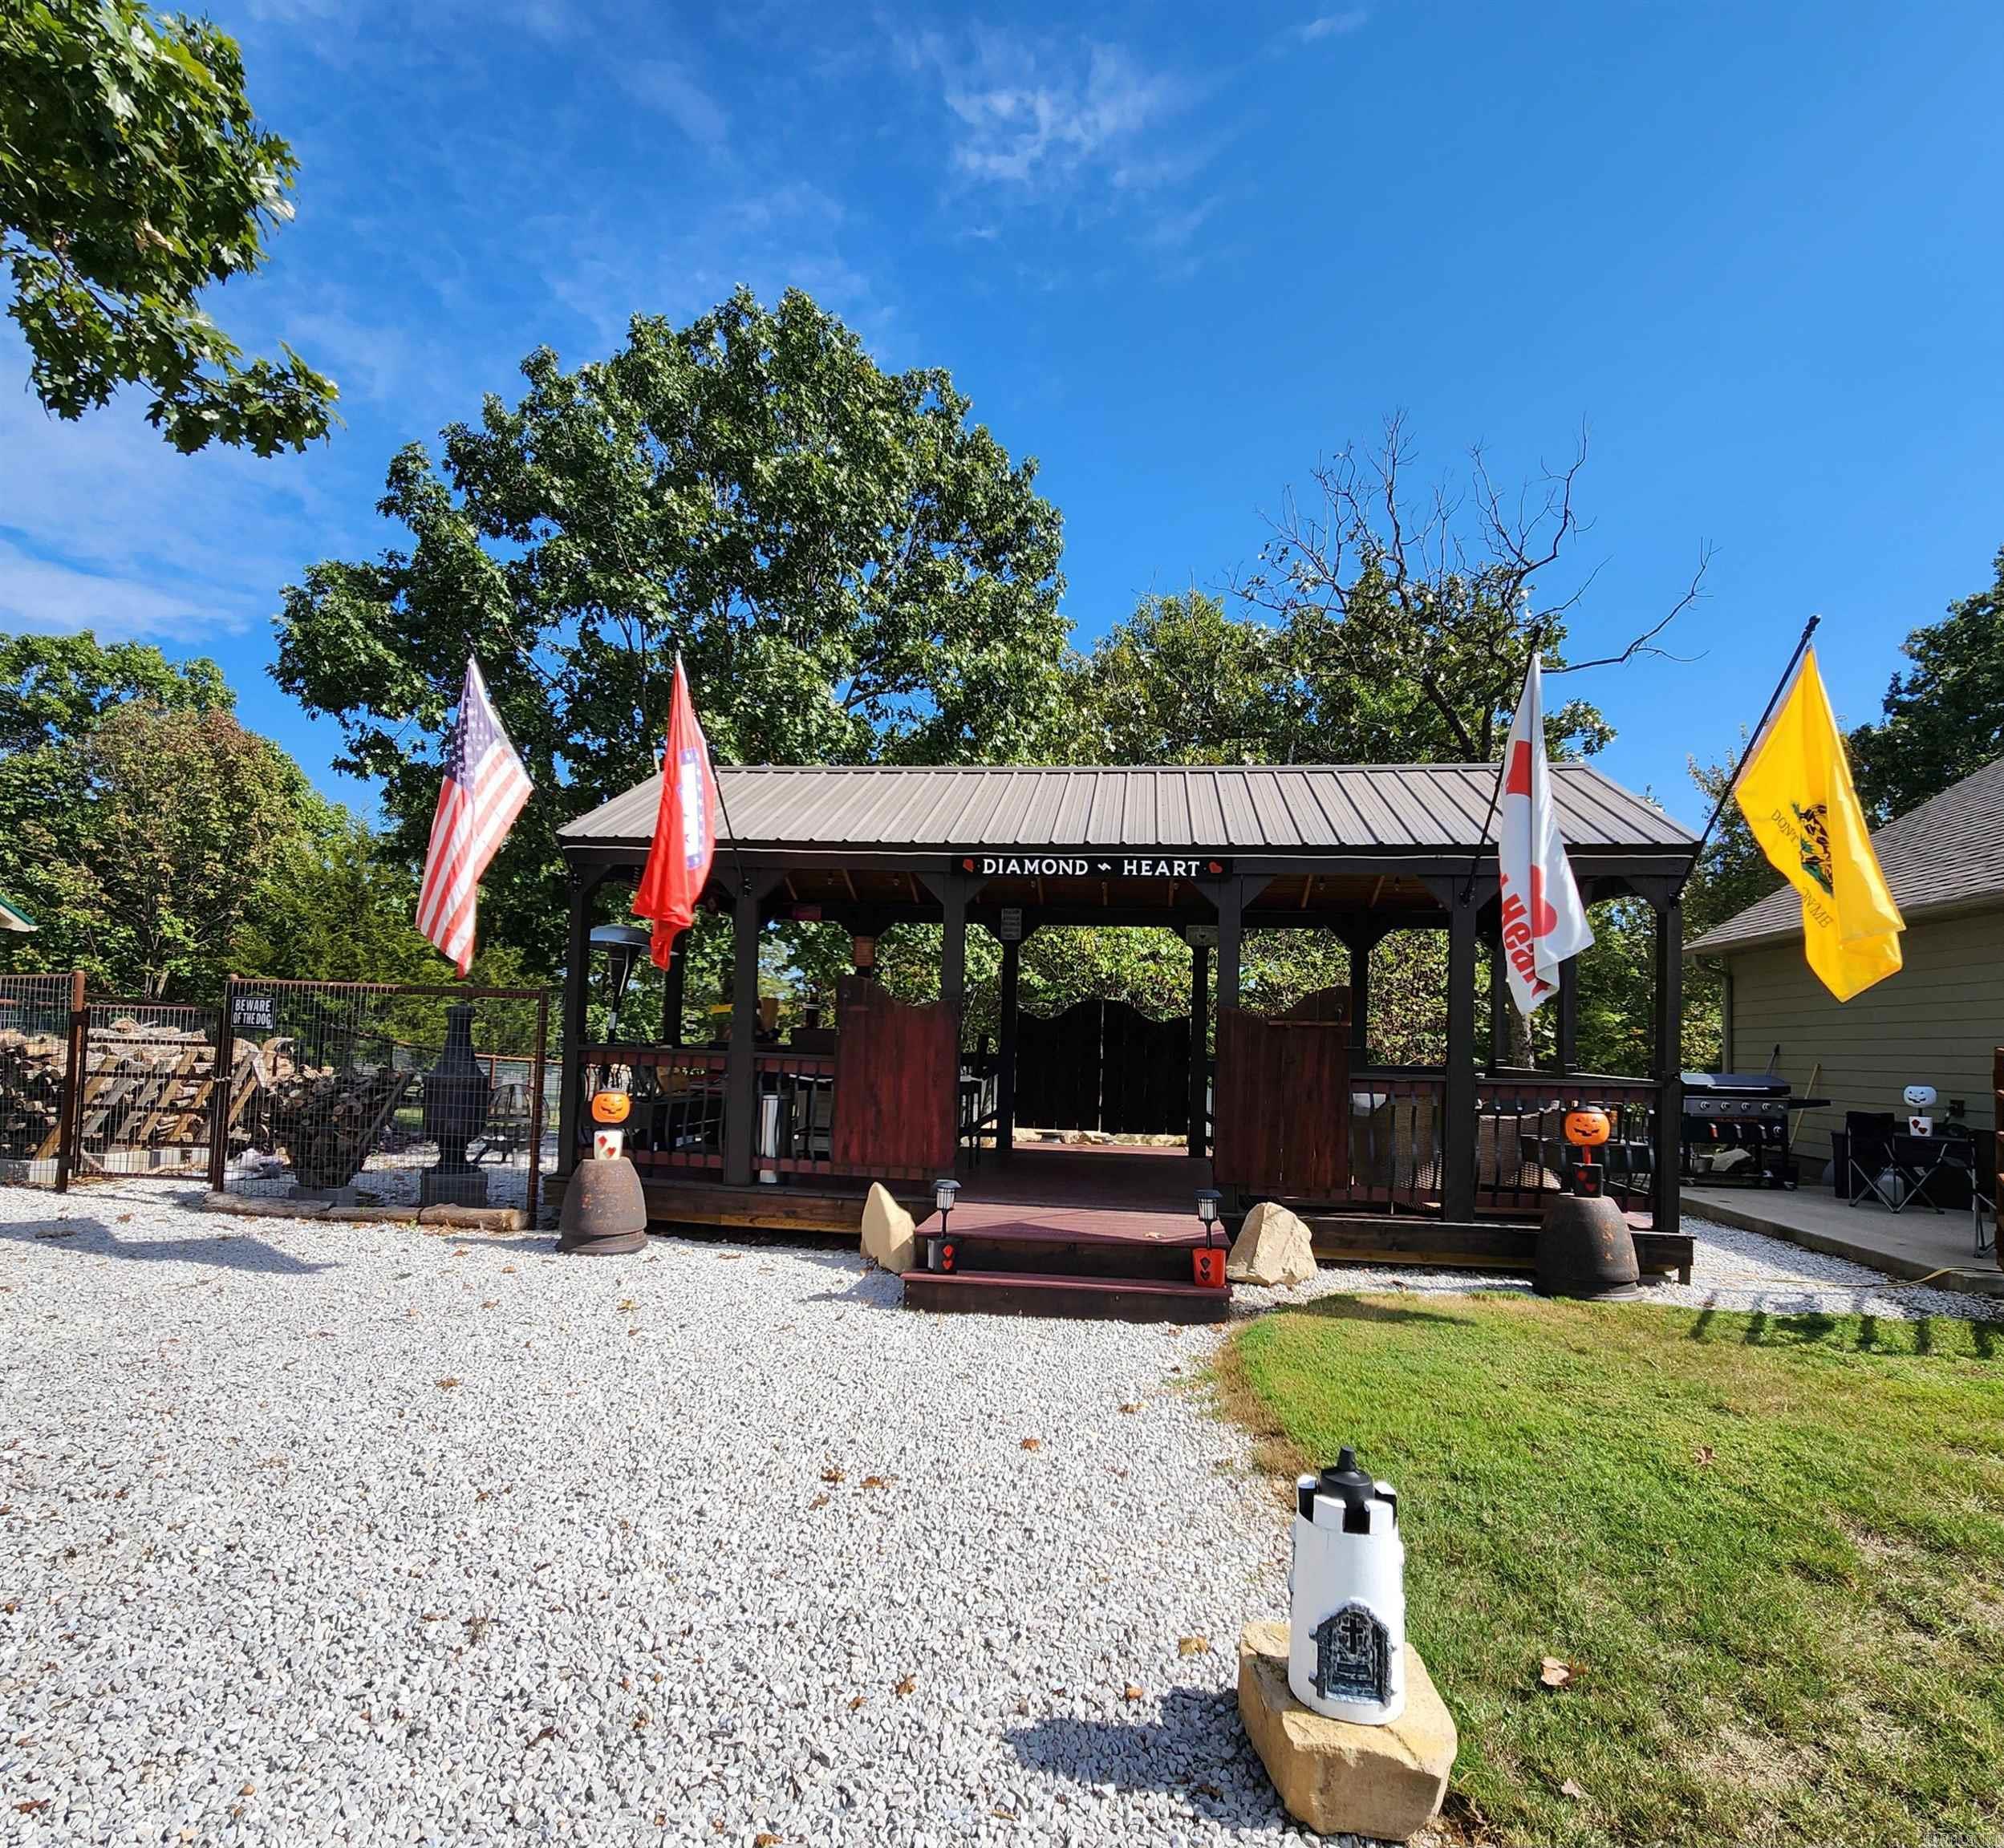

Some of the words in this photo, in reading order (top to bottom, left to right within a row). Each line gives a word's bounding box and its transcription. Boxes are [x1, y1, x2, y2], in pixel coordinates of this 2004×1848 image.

[982, 858, 1089, 876] DIAMOND
[1122, 859, 1200, 877] HEART
[235, 999, 272, 1012] BEWARE
[233, 1011, 242, 1024] OF
[243, 1012, 257, 1025] THE
[256, 1012, 271, 1026] DOG
